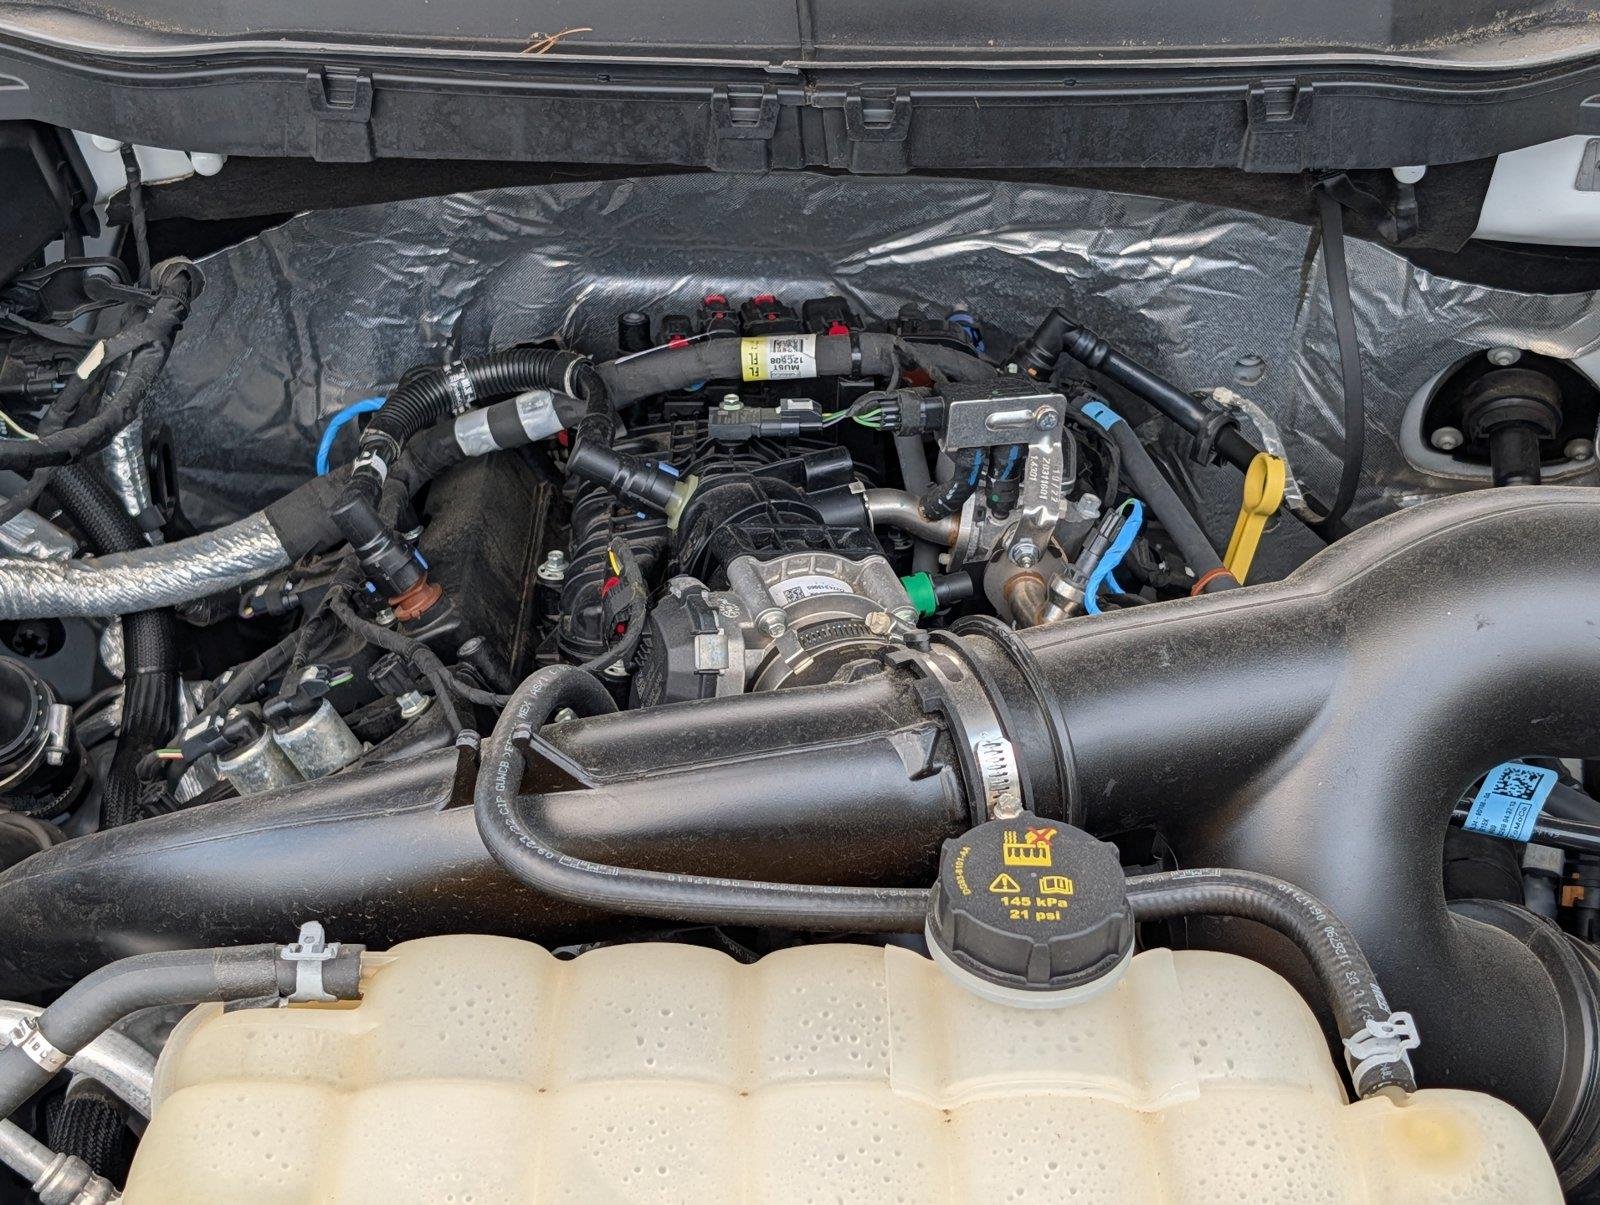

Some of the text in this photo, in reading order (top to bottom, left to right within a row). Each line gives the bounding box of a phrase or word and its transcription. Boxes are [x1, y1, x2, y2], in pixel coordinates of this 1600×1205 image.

[1000, 896, 1068, 908] 145 kPa
[1009, 910, 1061, 922] 21 psi
